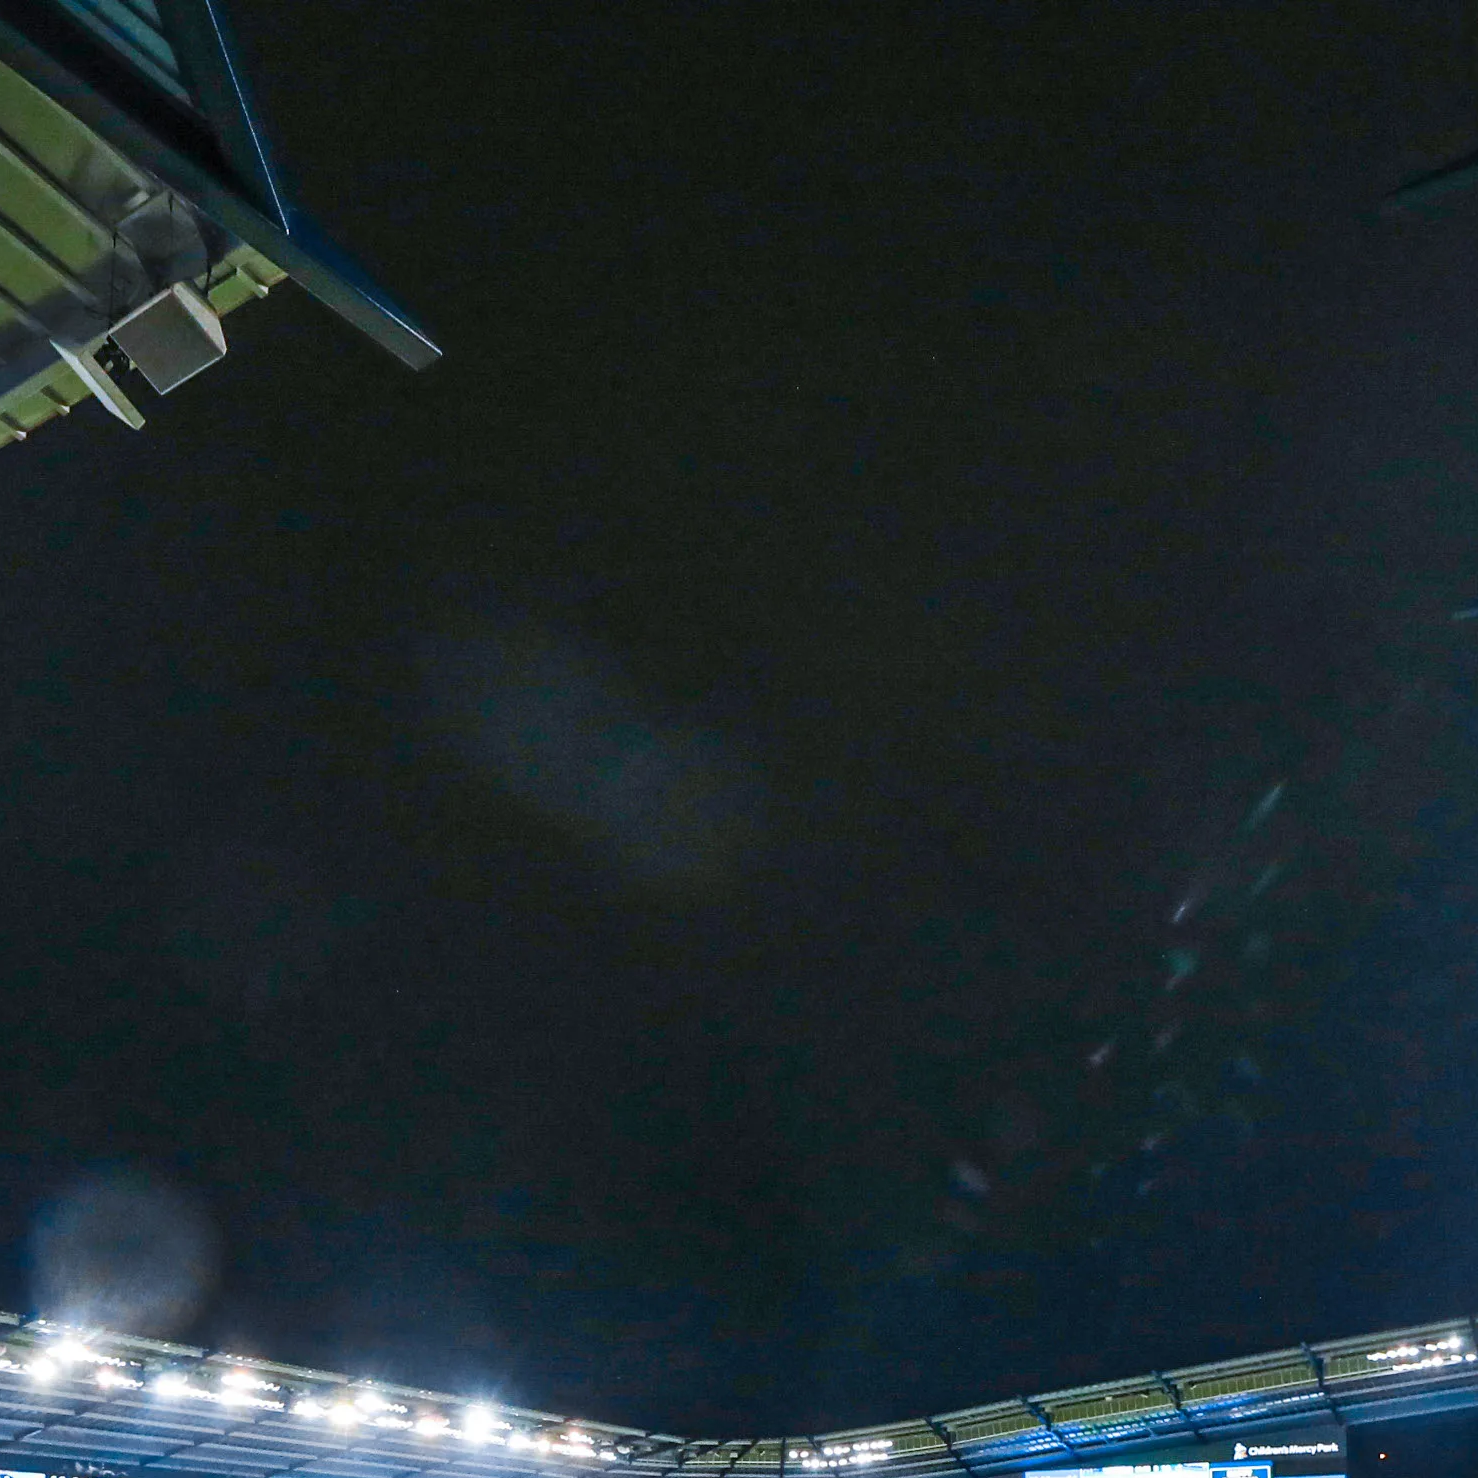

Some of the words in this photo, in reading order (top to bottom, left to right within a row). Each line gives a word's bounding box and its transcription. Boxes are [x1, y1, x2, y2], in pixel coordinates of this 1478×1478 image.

[1248, 1445, 1289, 1456] Children's
[1289, 1444, 1317, 1456] Mercy
[1317, 1442, 1339, 1453] Park
